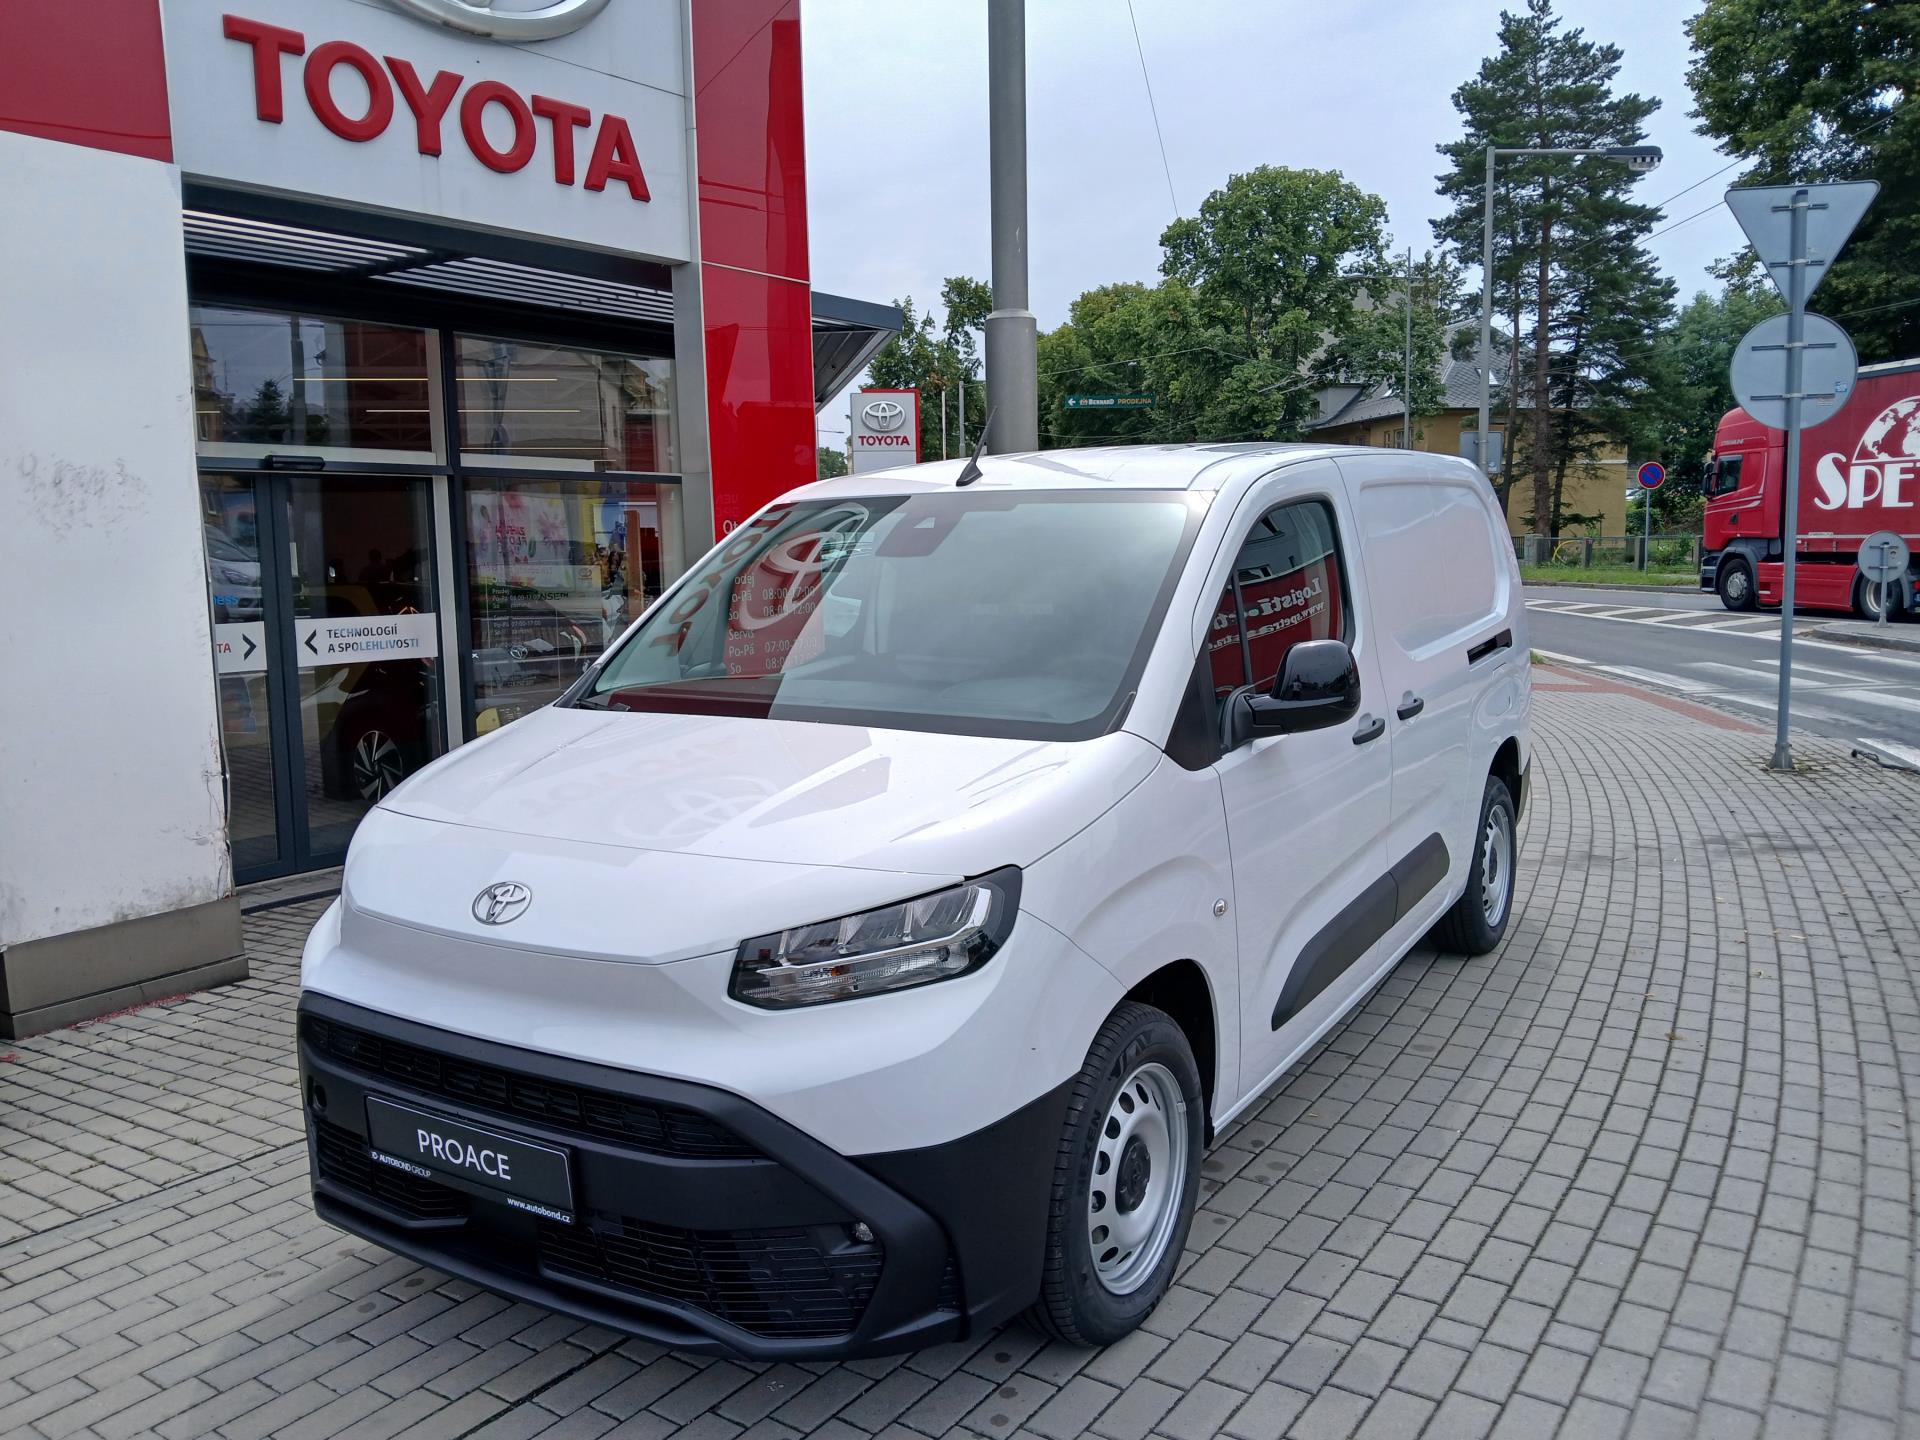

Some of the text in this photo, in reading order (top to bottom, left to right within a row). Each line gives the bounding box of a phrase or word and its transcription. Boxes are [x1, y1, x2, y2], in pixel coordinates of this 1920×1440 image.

[222, 13, 652, 203] TOYOTA
[858, 435, 911, 447] TOYOTA
[1814, 452, 1920, 510] SPE
[735, 573, 755, 588] odej
[731, 588, 753, 603] o-Pá
[326, 622, 398, 640] TECHNOLOGIÍ
[728, 628, 755, 641] Servis
[328, 638, 419, 653] A SPOLEHLIVOSTI
[728, 641, 755, 658] Po-Pá
[730, 661, 742, 675] So
[417, 1128, 512, 1181] PROACE
[379, 1153, 432, 1178] AUTOBOND GROUP
[507, 1197, 571, 1223] www.autobond.cz
